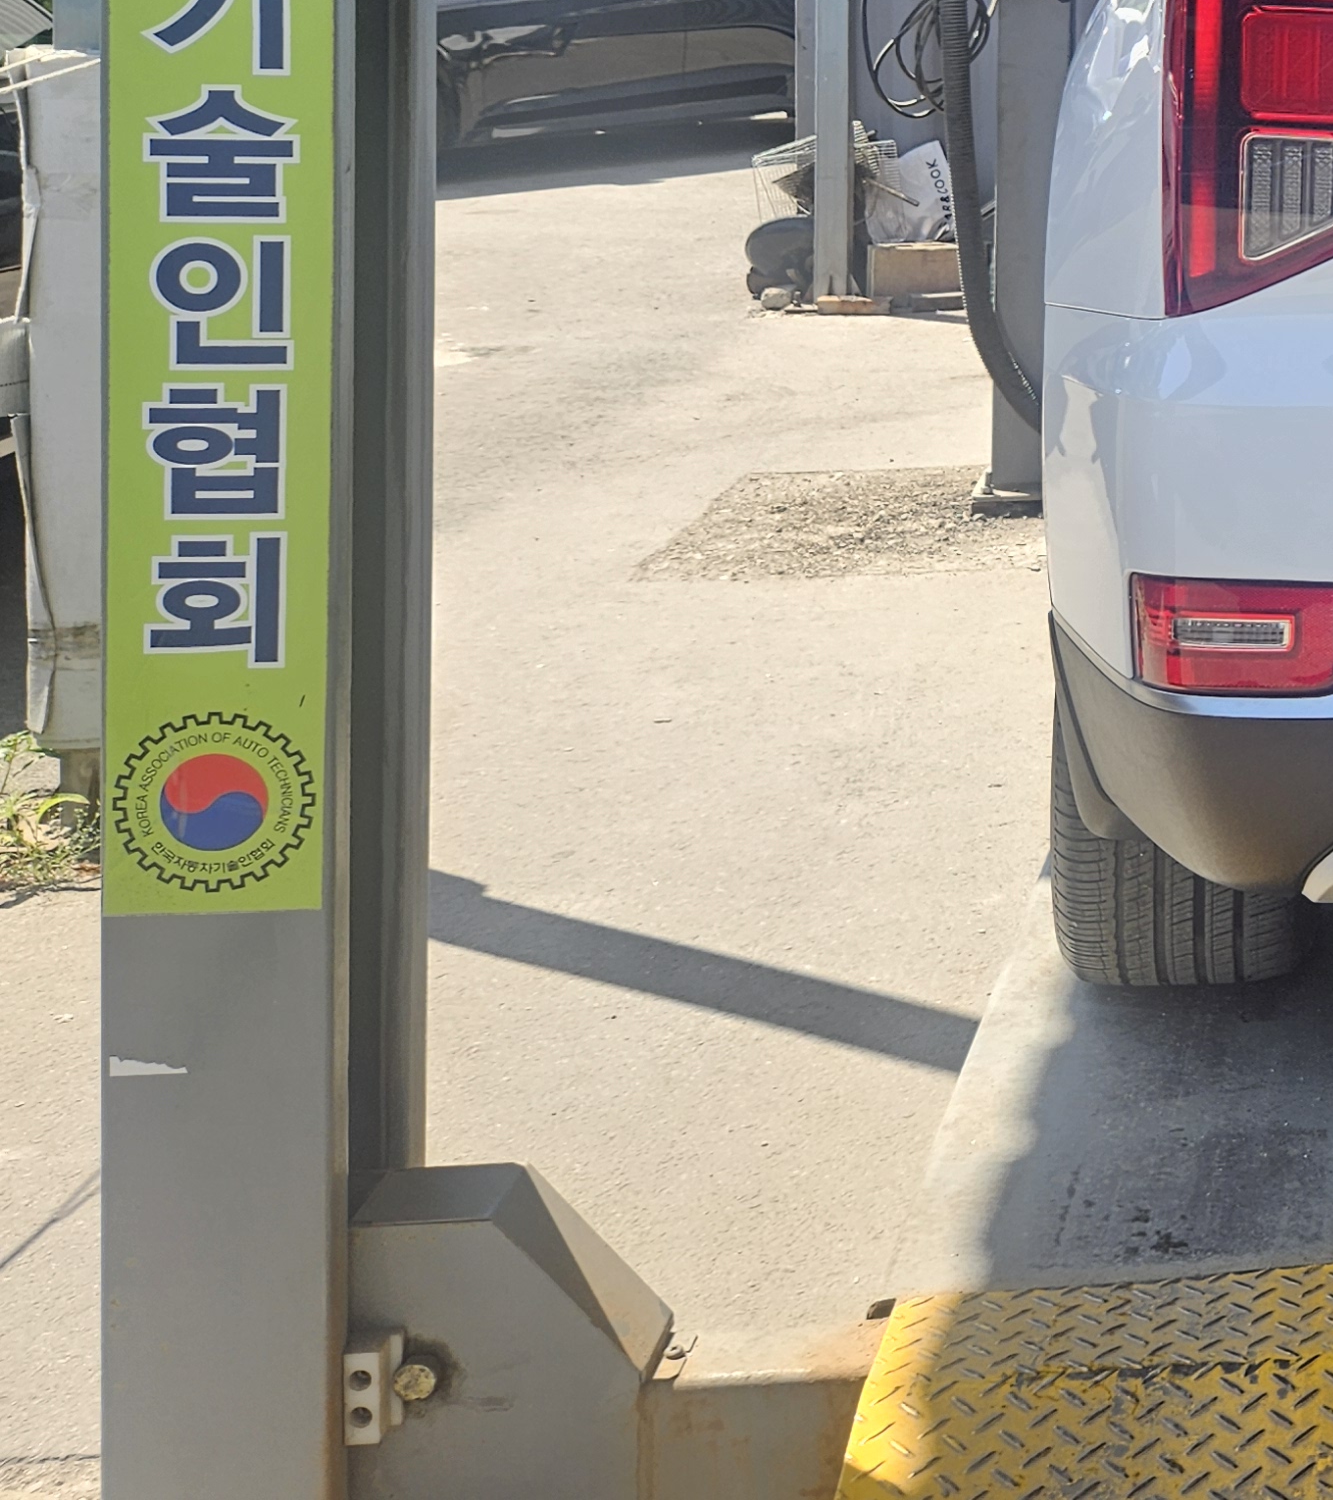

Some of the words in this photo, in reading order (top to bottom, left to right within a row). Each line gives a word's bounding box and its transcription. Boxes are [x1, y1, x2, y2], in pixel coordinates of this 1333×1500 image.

[211, 732, 231, 743] OF
[233, 736, 270, 758] AUTO
[139, 732, 208, 791] ASSOCIATION
[267, 755, 293, 834] TECHNICIANS
[135, 794, 154, 837] KOREA
[151, 838, 276, 874] 한국자동차기술인협회
